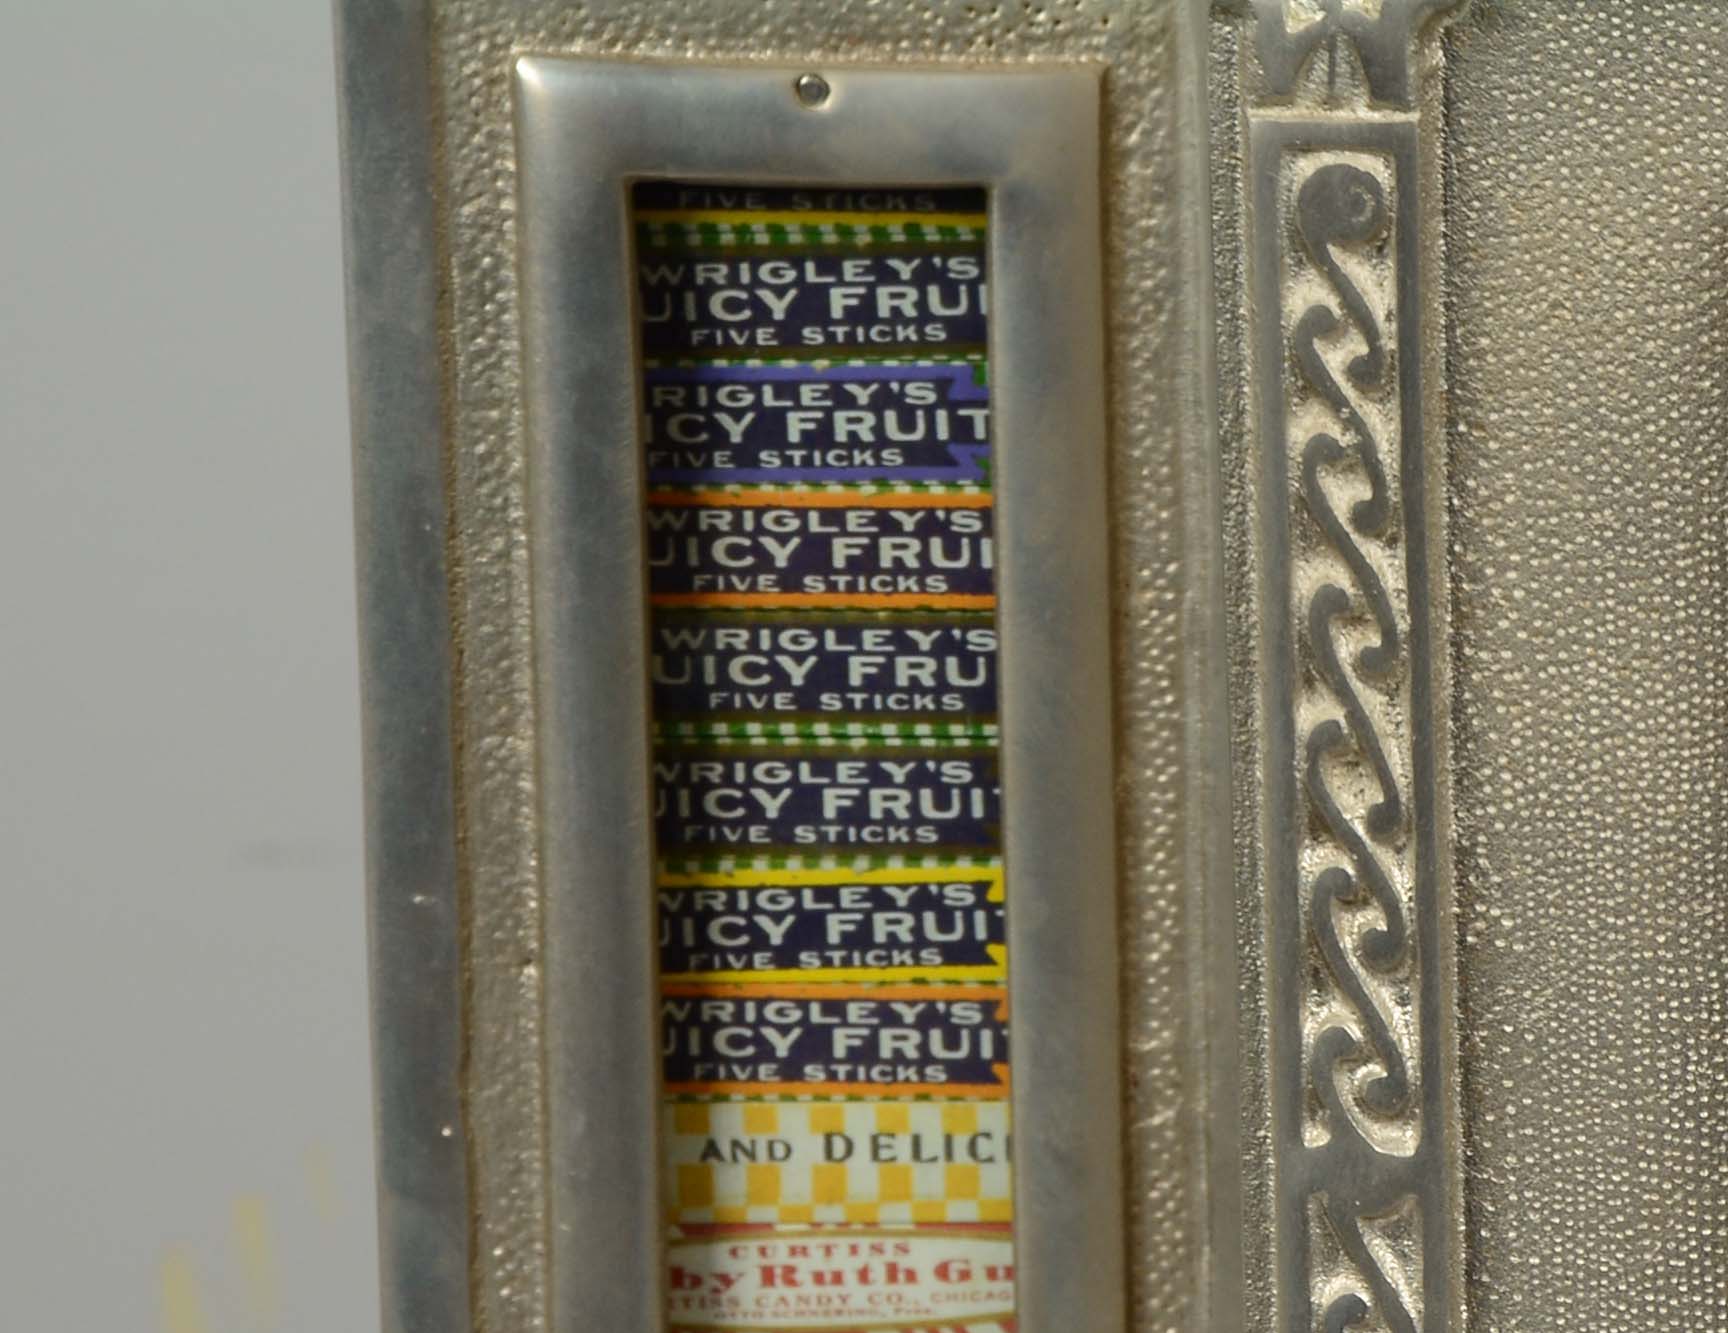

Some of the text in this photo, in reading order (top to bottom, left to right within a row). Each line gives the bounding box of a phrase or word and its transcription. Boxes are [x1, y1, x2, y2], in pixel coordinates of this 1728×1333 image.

[681, 193, 936, 211] FIVE STICKS
[641, 256, 979, 286] WRIGLEY'S
[691, 323, 947, 347] FIVE STICKS
[786, 408, 989, 443] FRUIT
[647, 448, 904, 470] FIVE STICKS
[647, 509, 983, 533] WRIGLEY'S
[692, 573, 949, 593] FIVE STICKS
[661, 628, 998, 651] WRIGLEY'S
[847, 654, 986, 687] FRU
[709, 691, 965, 712] FIVE STICKS
[822, 787, 1001, 820] FRUI
[684, 824, 940, 844] FIVE STICKS
[826, 909, 1006, 945] FRUI
[688, 946, 943, 971] FIVE STICKS
[831, 1027, 1009, 1060] FRUI
[694, 1063, 948, 1083] FIVE STICKS
[699, 1137, 795, 1164] AND
[728, 1241, 912, 1260] CURTISS
[758, 1261, 918, 1289] Ruth
[755, 1292, 852, 1309] CANDY
